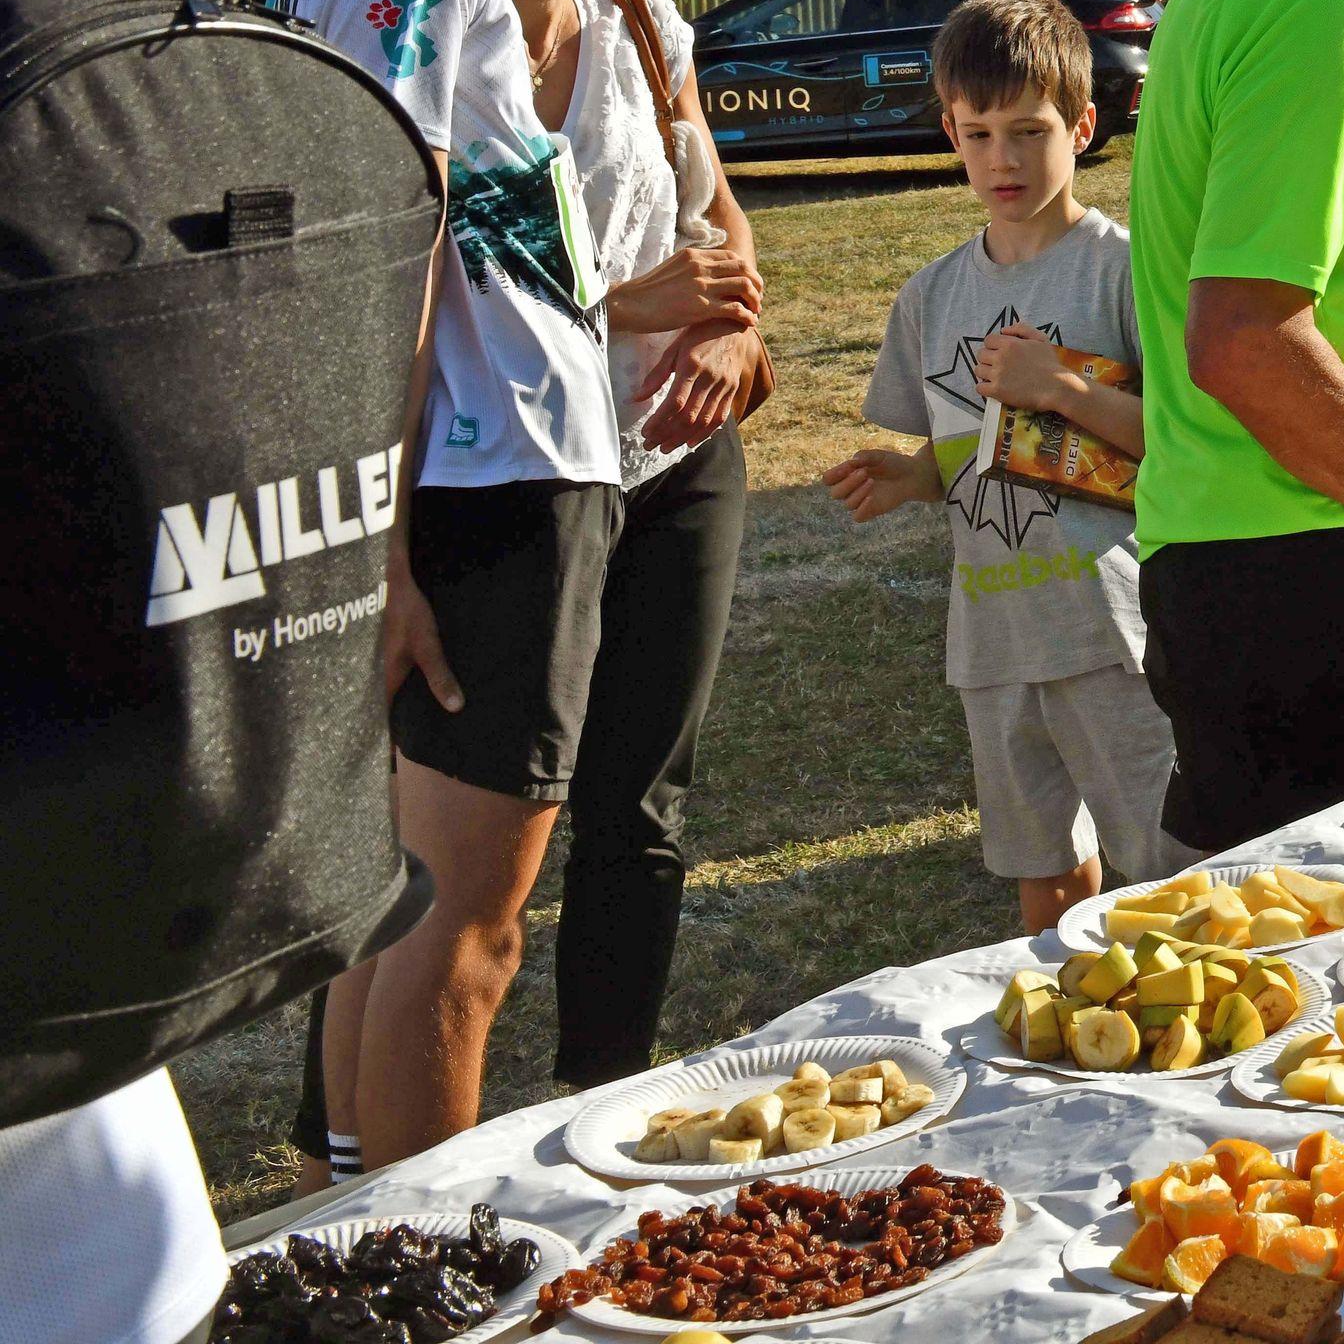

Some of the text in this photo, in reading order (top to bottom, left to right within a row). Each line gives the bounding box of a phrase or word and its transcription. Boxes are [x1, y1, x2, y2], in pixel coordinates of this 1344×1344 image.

[706, 87, 811, 113] IONIQ
[768, 114, 824, 125] HYBRID
[234, 580, 388, 661] by Honeywell
